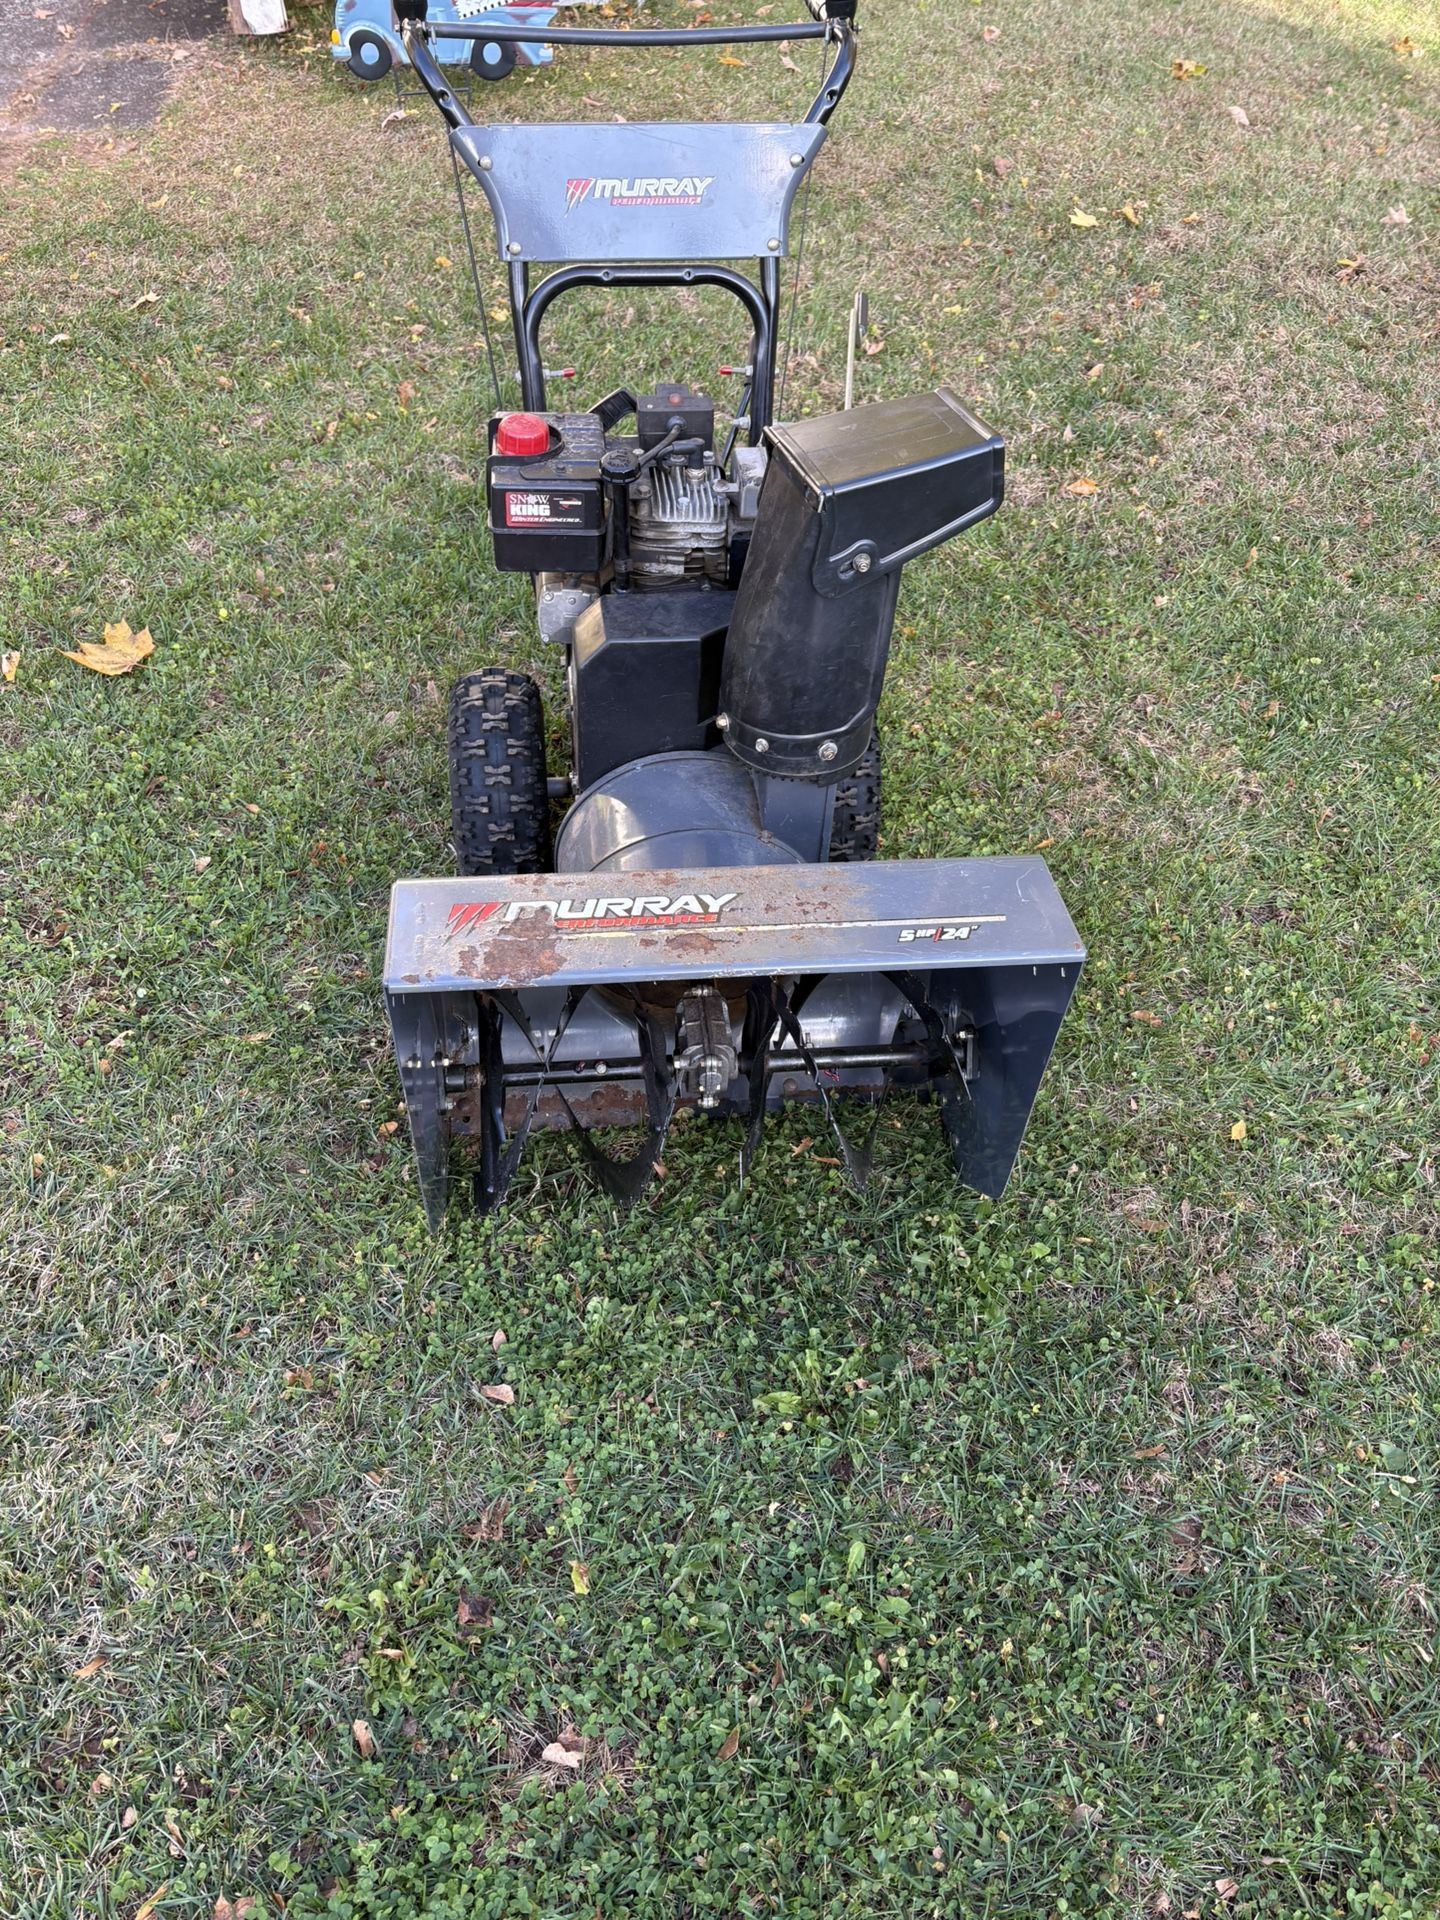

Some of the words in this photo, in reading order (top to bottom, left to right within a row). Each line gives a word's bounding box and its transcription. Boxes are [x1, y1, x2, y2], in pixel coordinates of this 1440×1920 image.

[593, 176, 716, 198] MURRAY
[510, 504, 551, 517] KING
[505, 893, 738, 922] MURRAY
[555, 914, 718, 929] ERFORMANCE
